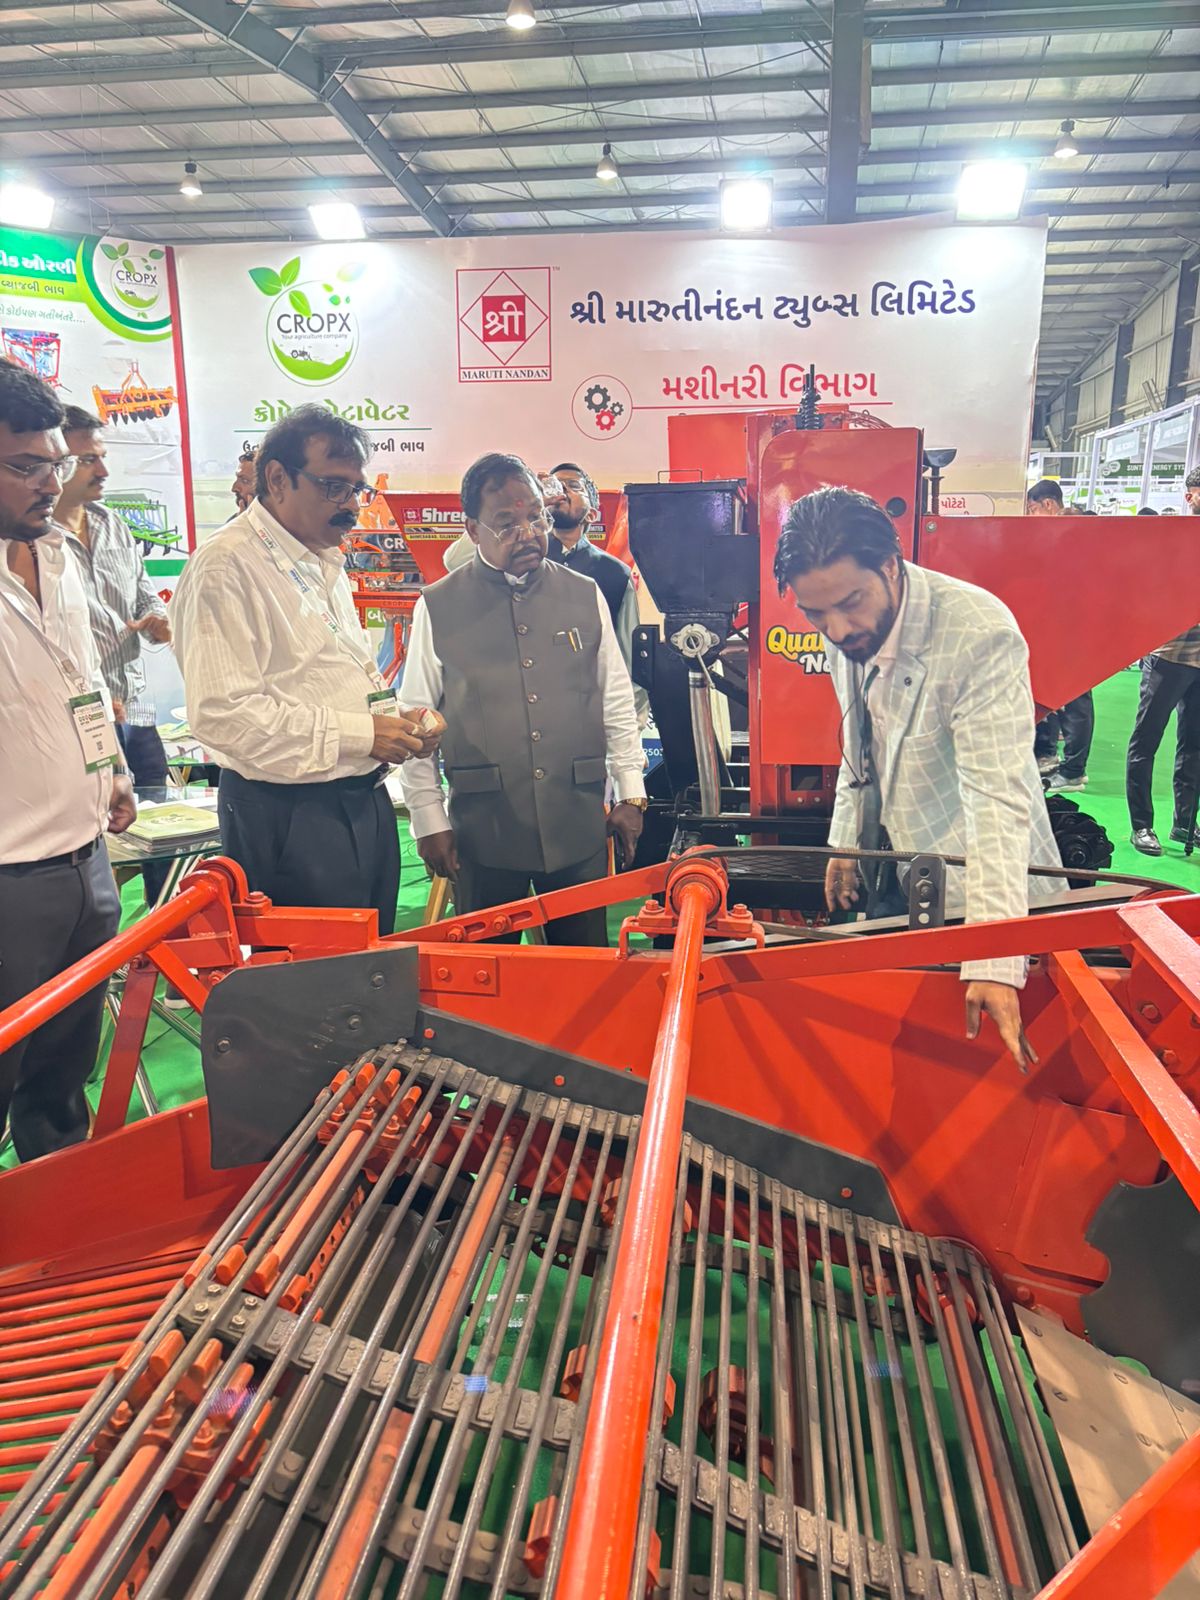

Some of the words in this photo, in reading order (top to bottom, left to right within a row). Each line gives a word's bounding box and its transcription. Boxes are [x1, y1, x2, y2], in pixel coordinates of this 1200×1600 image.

[116, 270, 158, 285] CROPX
[44, 285, 65, 296] ભાવ
[570, 291, 606, 324] શ્રી
[615, 288, 764, 323] મારુતીનંદન
[773, 293, 859, 329] ટ્યુબ્સ
[870, 279, 976, 317] લિમિટેડ
[276, 312, 352, 334] CROPX
[484, 300, 524, 337] श्री
[462, 370, 503, 380] MARUTI
[505, 369, 549, 379] NANDAN
[662, 364, 768, 400] મશીનરી
[780, 363, 878, 398] વિભાગ
[400, 441, 425, 452] ભાવ
[1151, 463, 1172, 471] NERGY
[384, 537, 405, 550] CR
